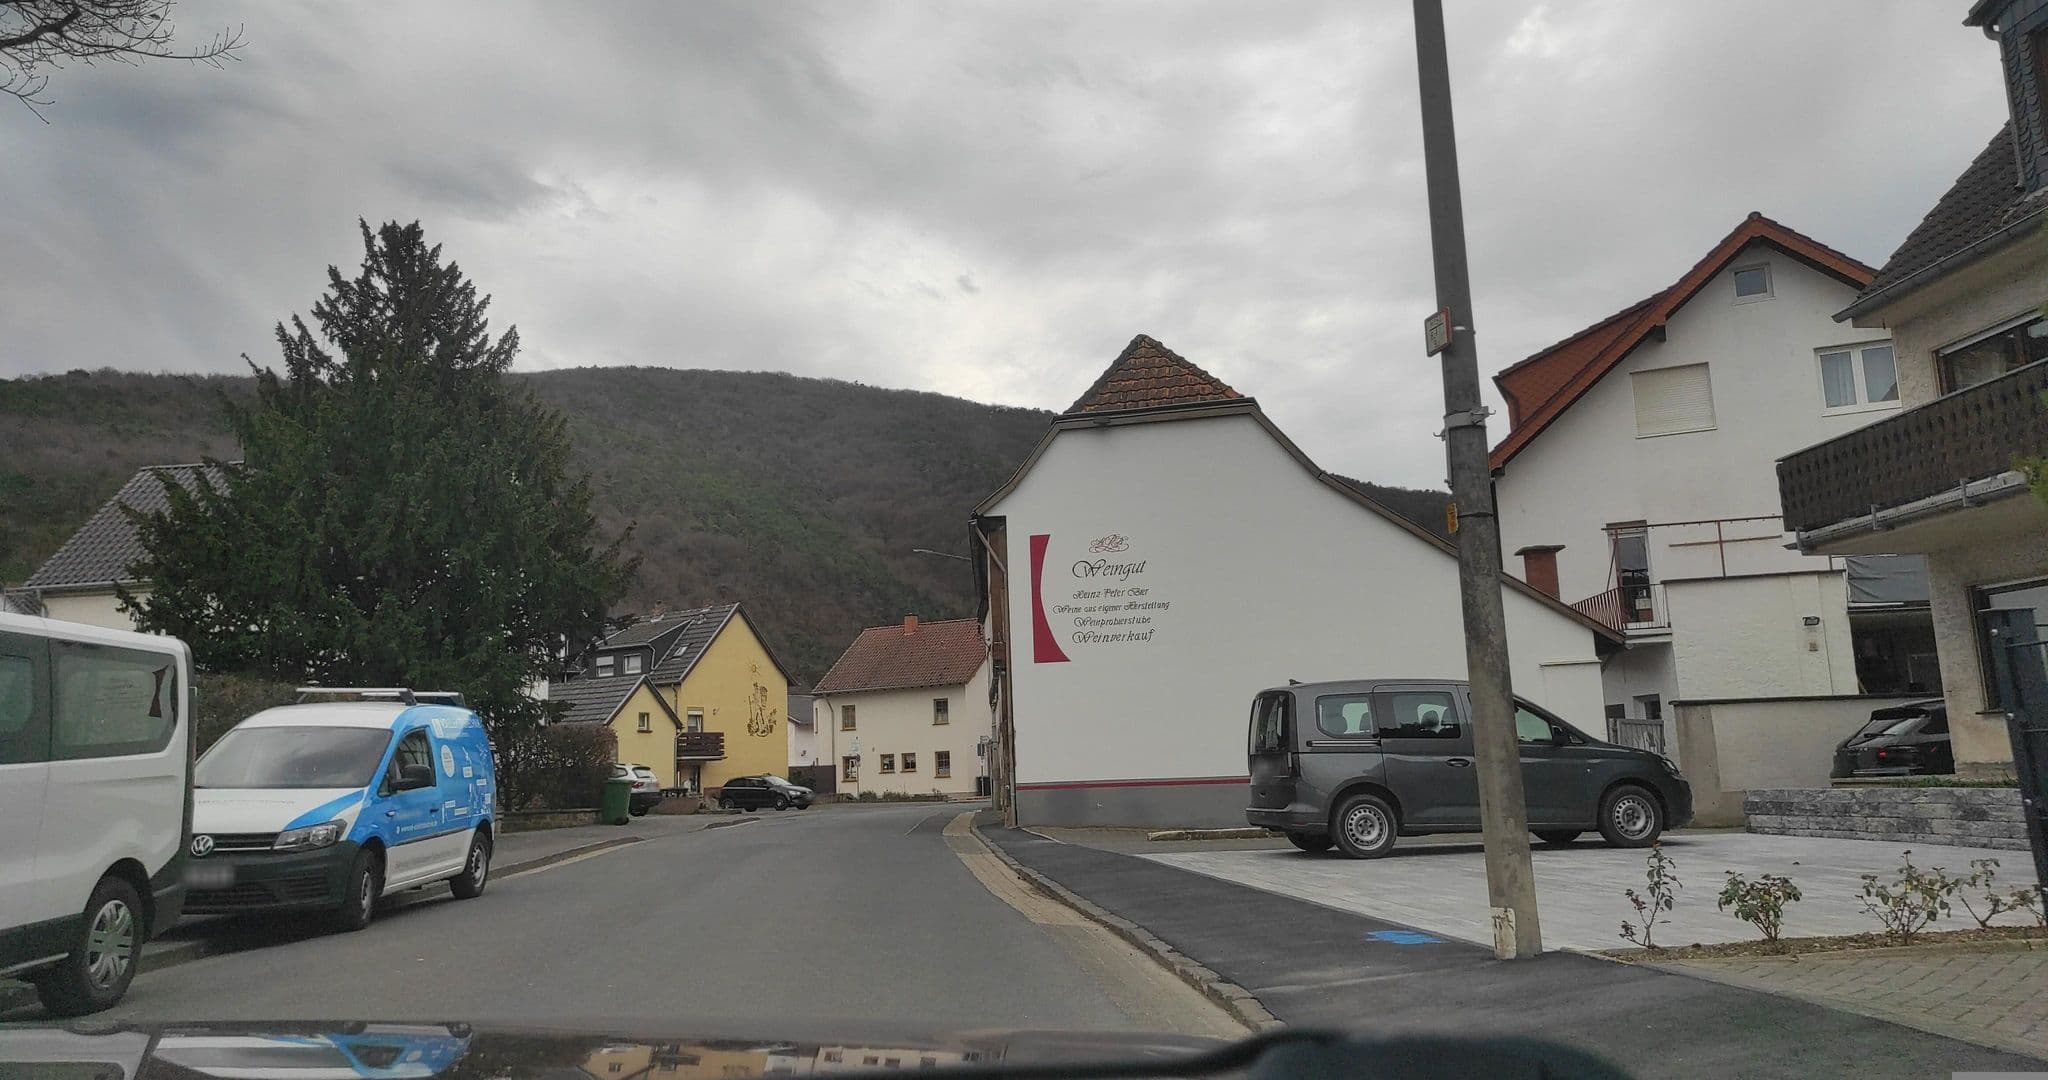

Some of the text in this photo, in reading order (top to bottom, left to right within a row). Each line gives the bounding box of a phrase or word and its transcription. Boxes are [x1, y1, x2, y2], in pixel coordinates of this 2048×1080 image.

[1072, 559, 1146, 581] Weingut
[1053, 604, 1082, 614] Weine
[1098, 604, 1121, 614] eigener
[1123, 601, 1170, 611] Herstellung
[1074, 616, 1151, 627] Weinprobierstube
[1072, 629, 1155, 643] Weinverkauf
